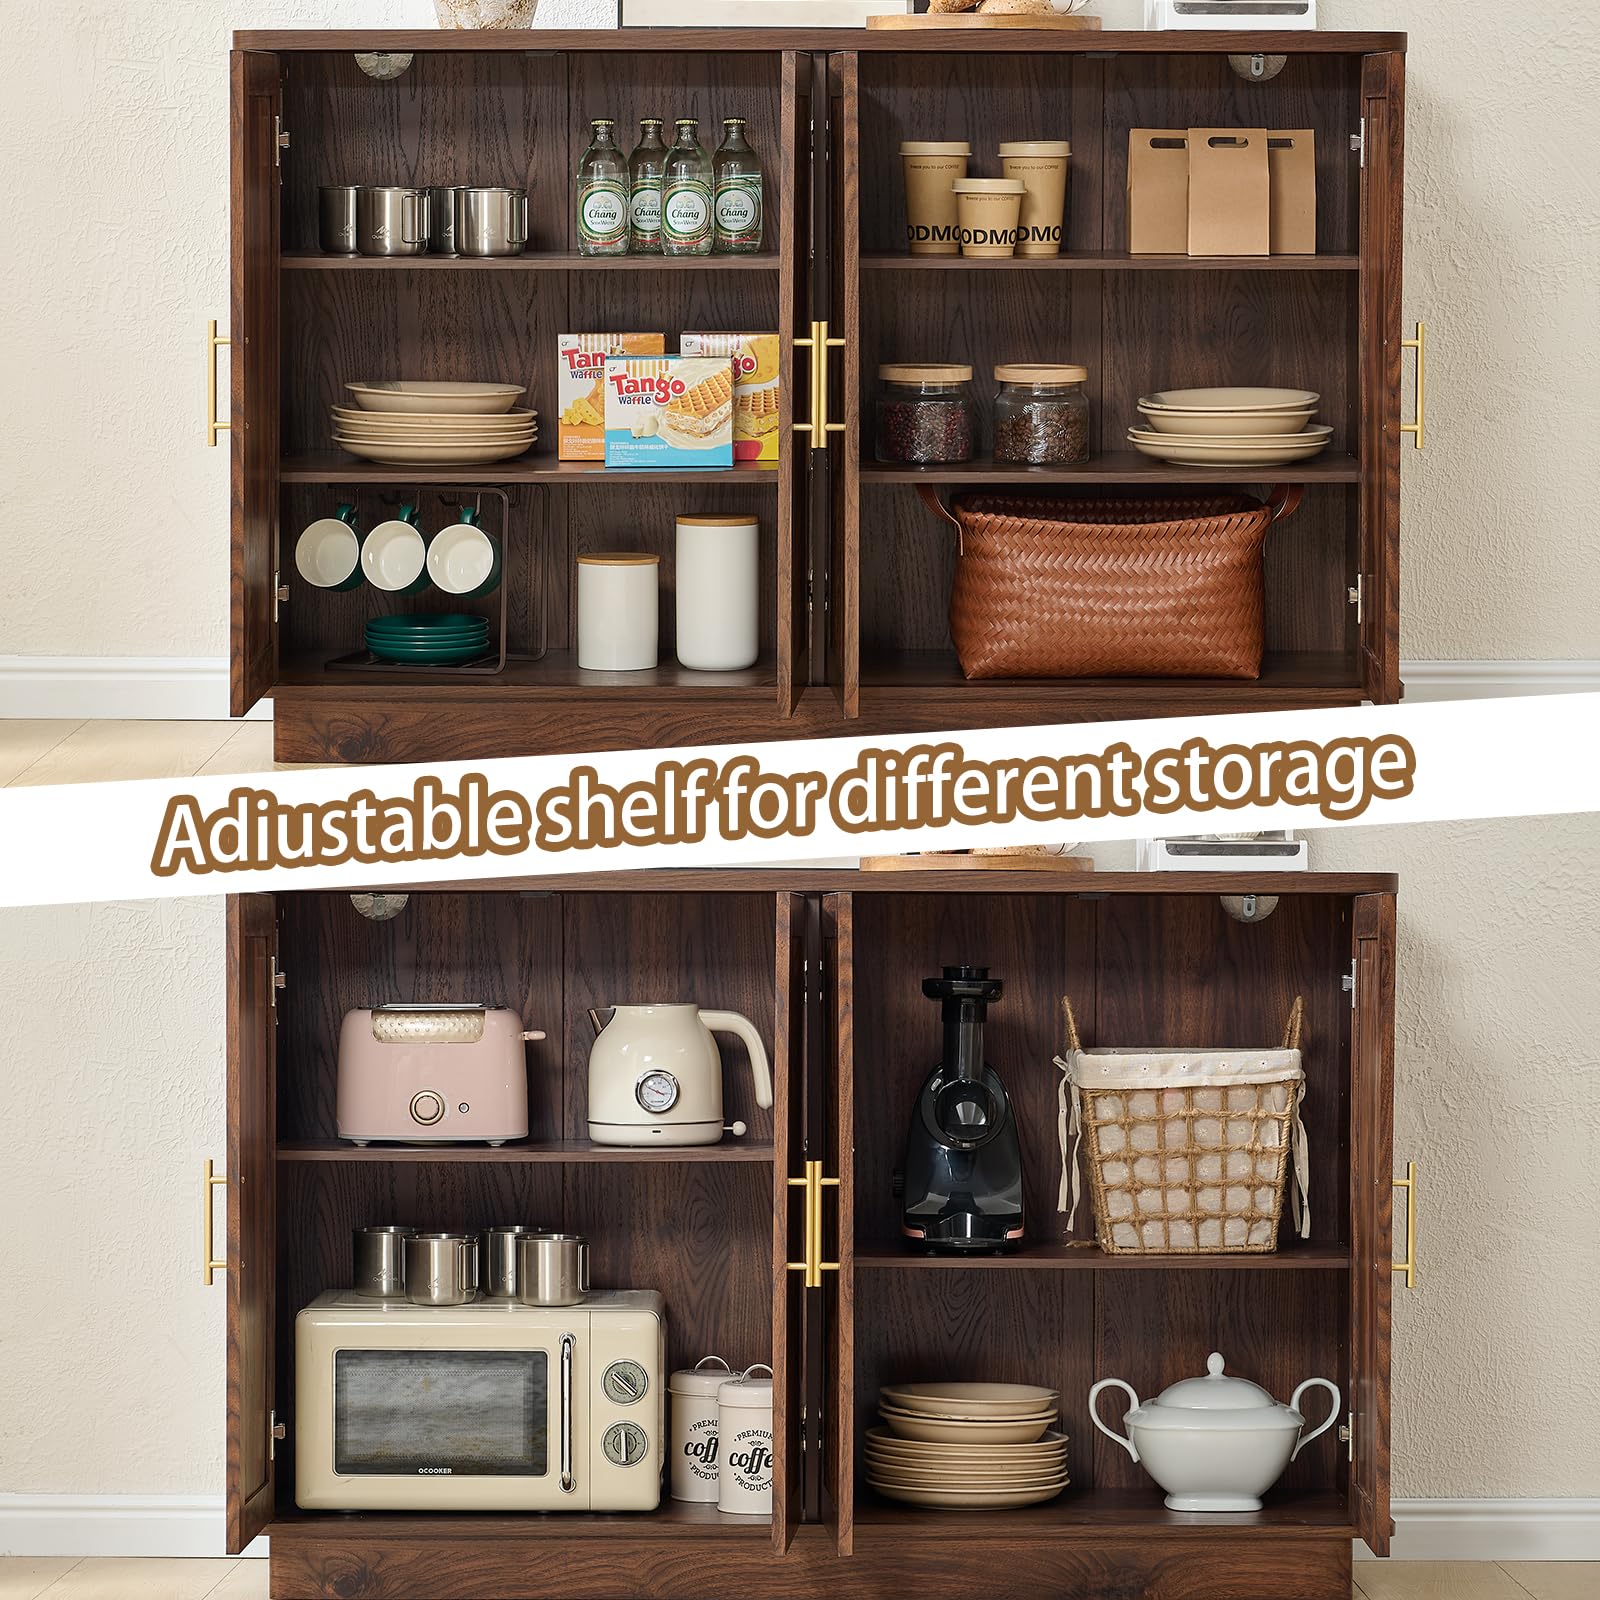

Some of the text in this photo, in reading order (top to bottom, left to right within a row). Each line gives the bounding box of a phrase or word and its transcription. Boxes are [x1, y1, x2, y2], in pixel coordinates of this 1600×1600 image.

[588, 209, 617, 220] Chang
[671, 209, 699, 220] Chang
[720, 207, 748, 218] Chang
[609, 374, 686, 403] Tango
[690, 1464, 719, 1480] PRODU
